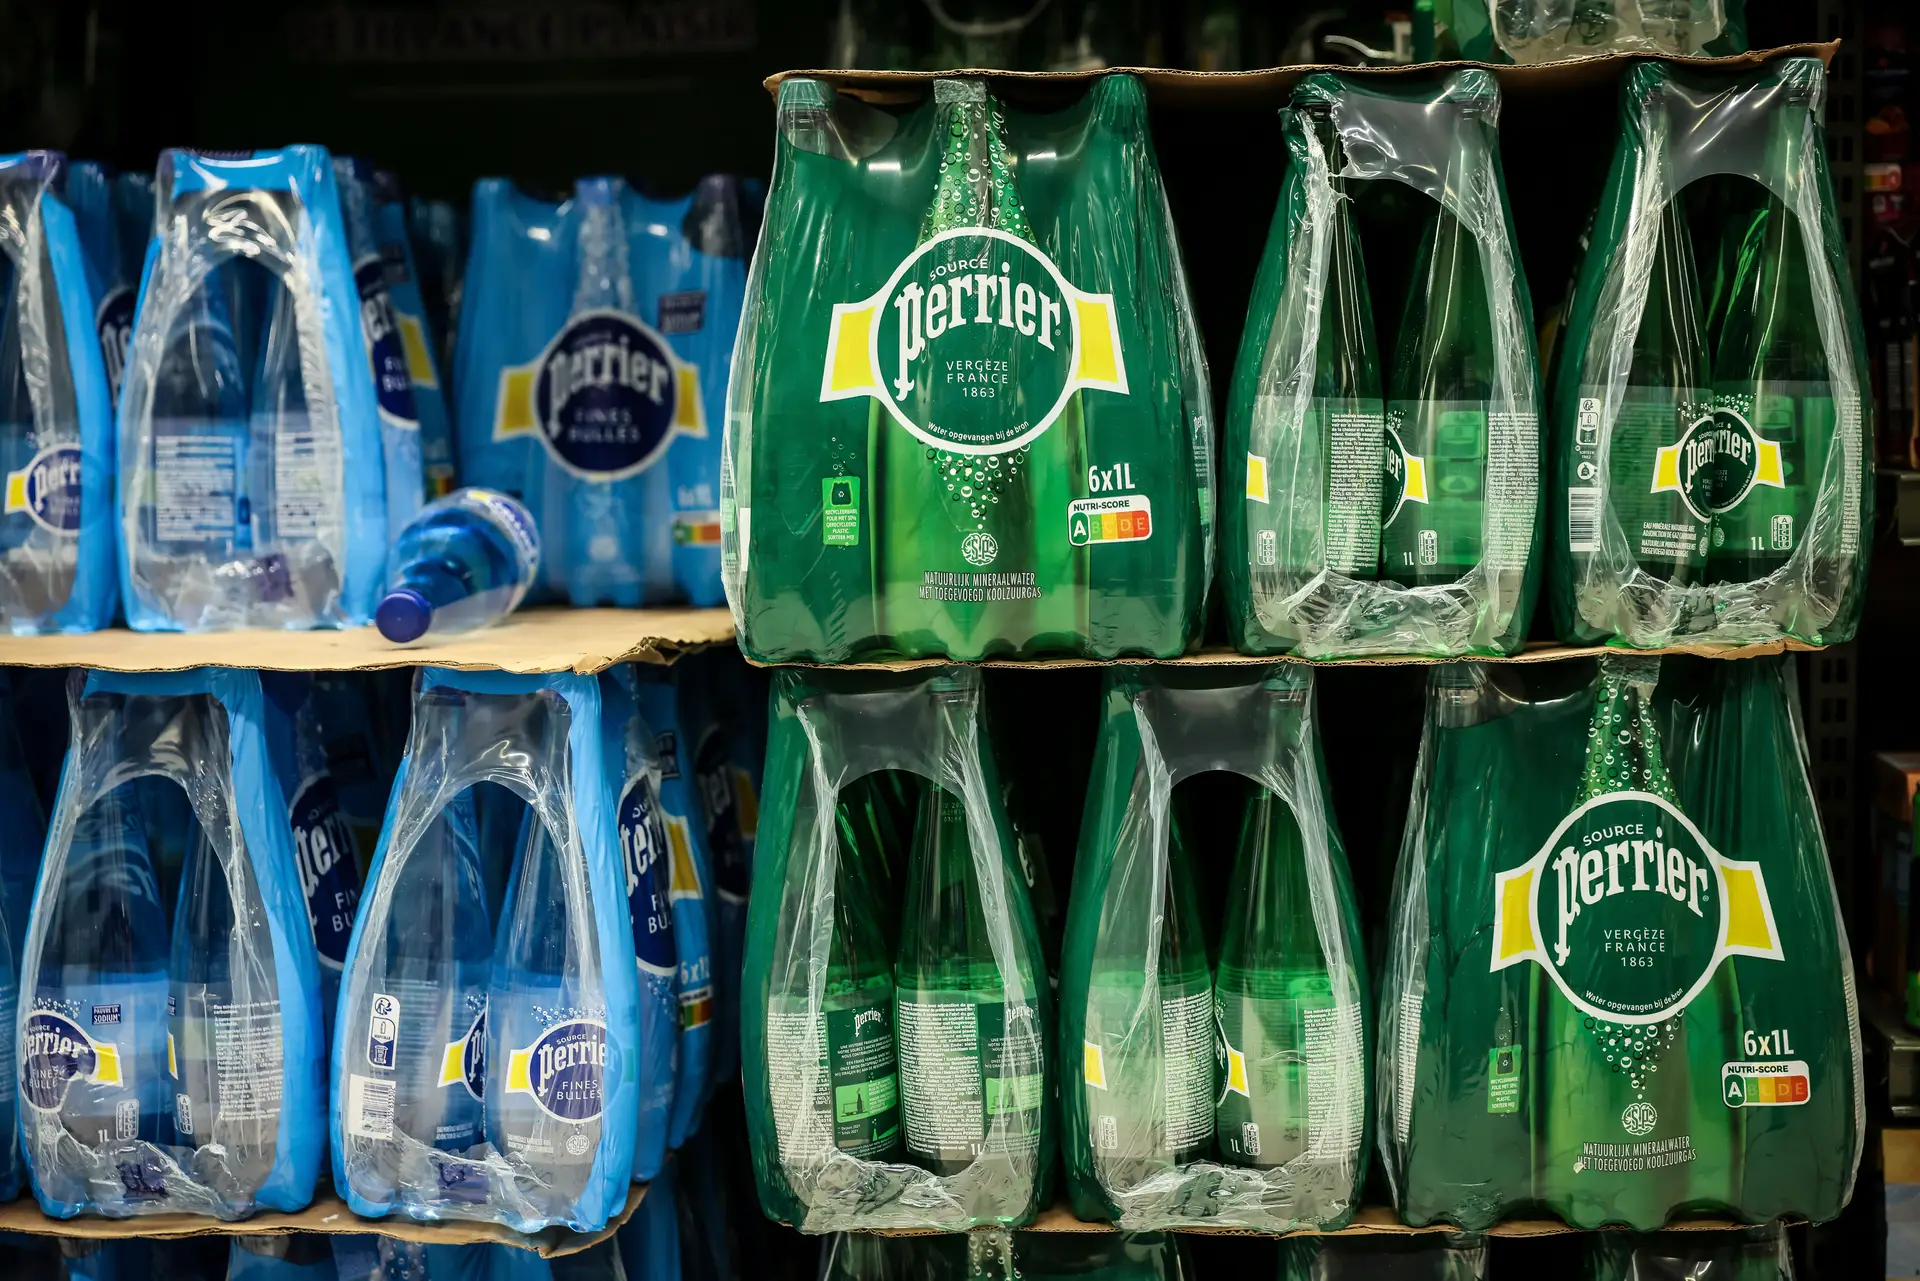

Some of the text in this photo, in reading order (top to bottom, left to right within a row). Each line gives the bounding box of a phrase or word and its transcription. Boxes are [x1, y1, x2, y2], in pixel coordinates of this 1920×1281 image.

[930, 258, 988, 281] SOURCE
[946, 359, 1009, 372] VERGÈZE
[946, 373, 1009, 384] FRANCE
[962, 387, 995, 398] 1863
[928, 420, 1029, 443] Water opgevangen bij de bron
[1088, 463, 1136, 492] 6x1L
[1073, 500, 1130, 511] NUTRI-SCORE
[1073, 520, 1087, 538] A
[1137, 517, 1145, 530] E
[1751, 536, 1764, 550] 1L
[1403, 552, 1414, 566] 1L
[924, 571, 1035, 587] NATUURLIJK MINERAALWATER
[919, 586, 1042, 602] MET TOEGEVOEGD KOOLZUURGAS
[1582, 824, 1644, 847] SOURCE
[1604, 928, 1665, 941] VERGÈZE
[1605, 942, 1665, 953] FRANCE
[1620, 956, 1654, 967] 1863
[1585, 988, 1683, 1013] Water opgevangen bij de bron
[556, 1034, 586, 1044] SOURCE
[1744, 1029, 1794, 1056] 6x1L
[1728, 1065, 1788, 1073] NUTRI-SCORE
[562, 1079, 599, 1090] FINES
[1727, 1082, 1743, 1097] A
[1795, 1083, 1804, 1095] E
[98, 1129, 110, 1142] 1L
[1231, 1138, 1241, 1154] 1L
[1584, 1136, 1690, 1157] NATUURLIJK MINERAALWATER
[1594, 1157, 1644, 1172] TOEGEVOEGD
[1646, 1148, 1697, 1170] KOOLZUURGAS
